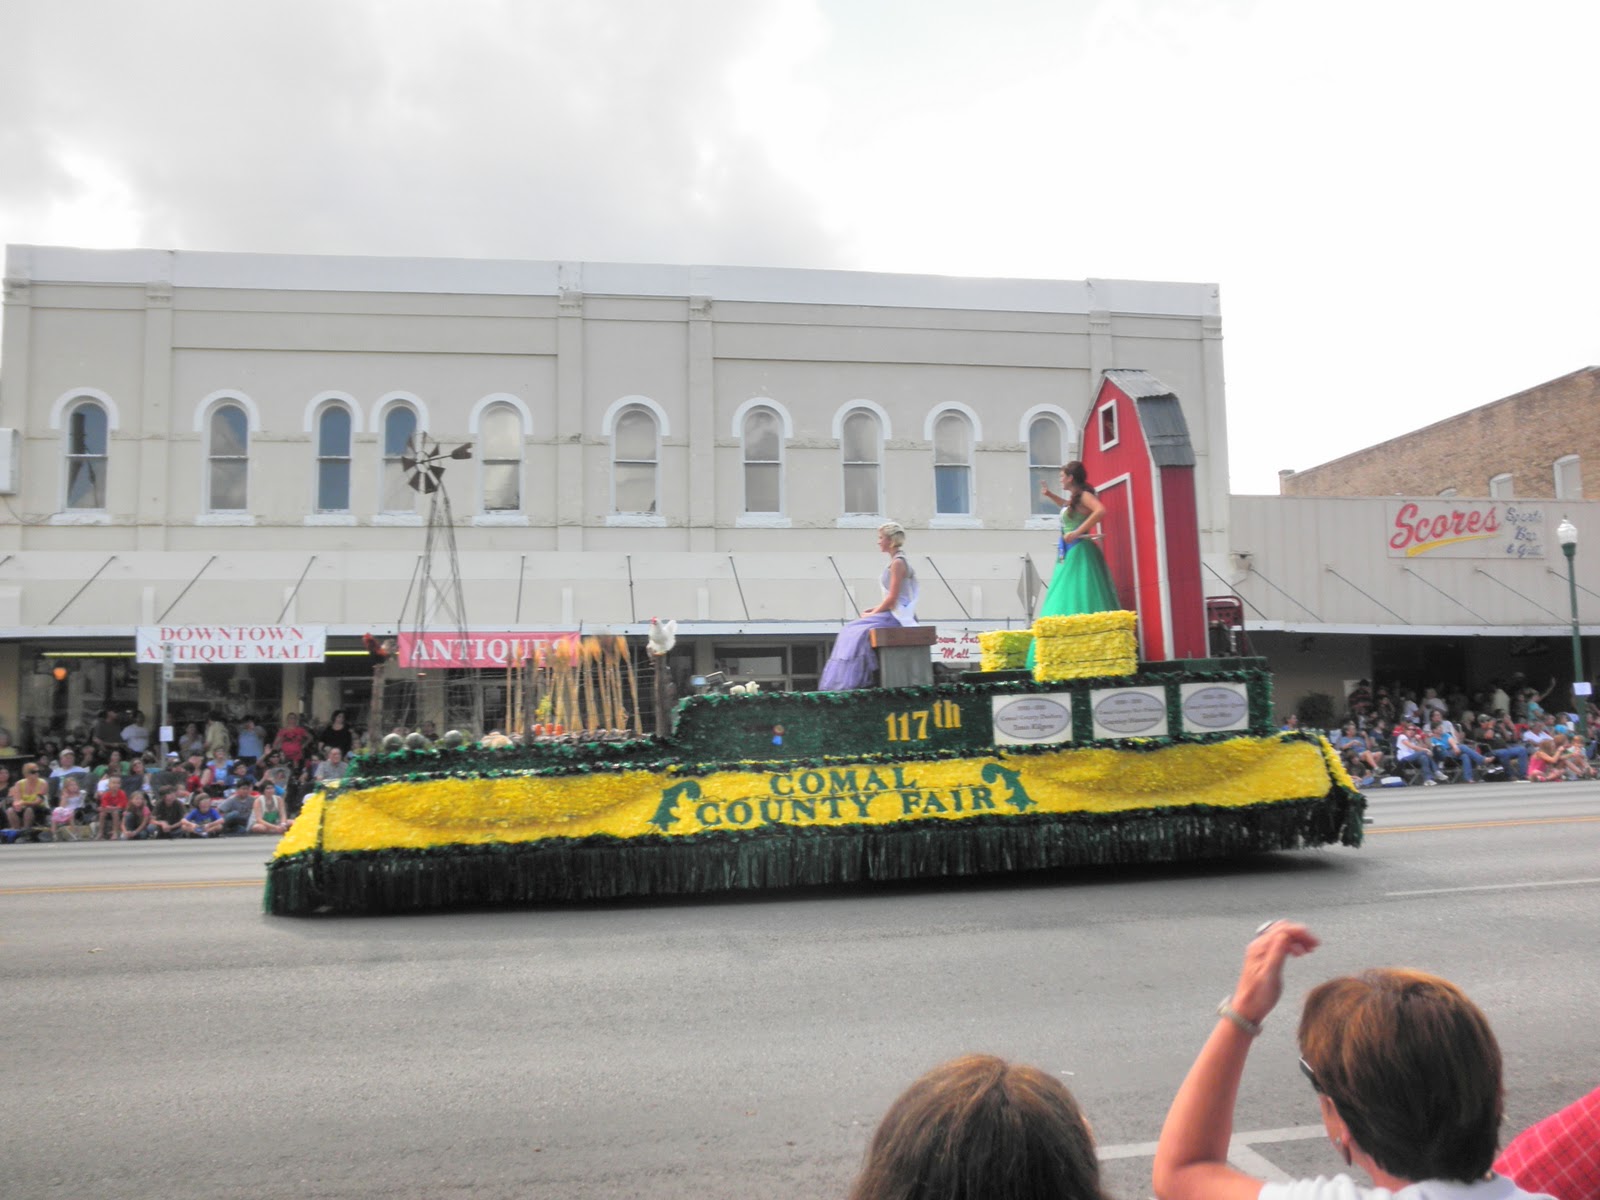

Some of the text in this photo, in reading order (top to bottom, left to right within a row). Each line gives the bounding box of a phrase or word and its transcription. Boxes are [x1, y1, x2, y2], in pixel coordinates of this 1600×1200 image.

[1389, 503, 1500, 549] Scores
[160, 626, 304, 641] DOWNTOWN
[256, 644, 320, 659] MALL
[941, 647, 970, 659] Mall
[885, 700, 961, 741] 117th
[770, 767, 917, 796] COMAL
[696, 787, 996, 827] COUNTY FAIR
